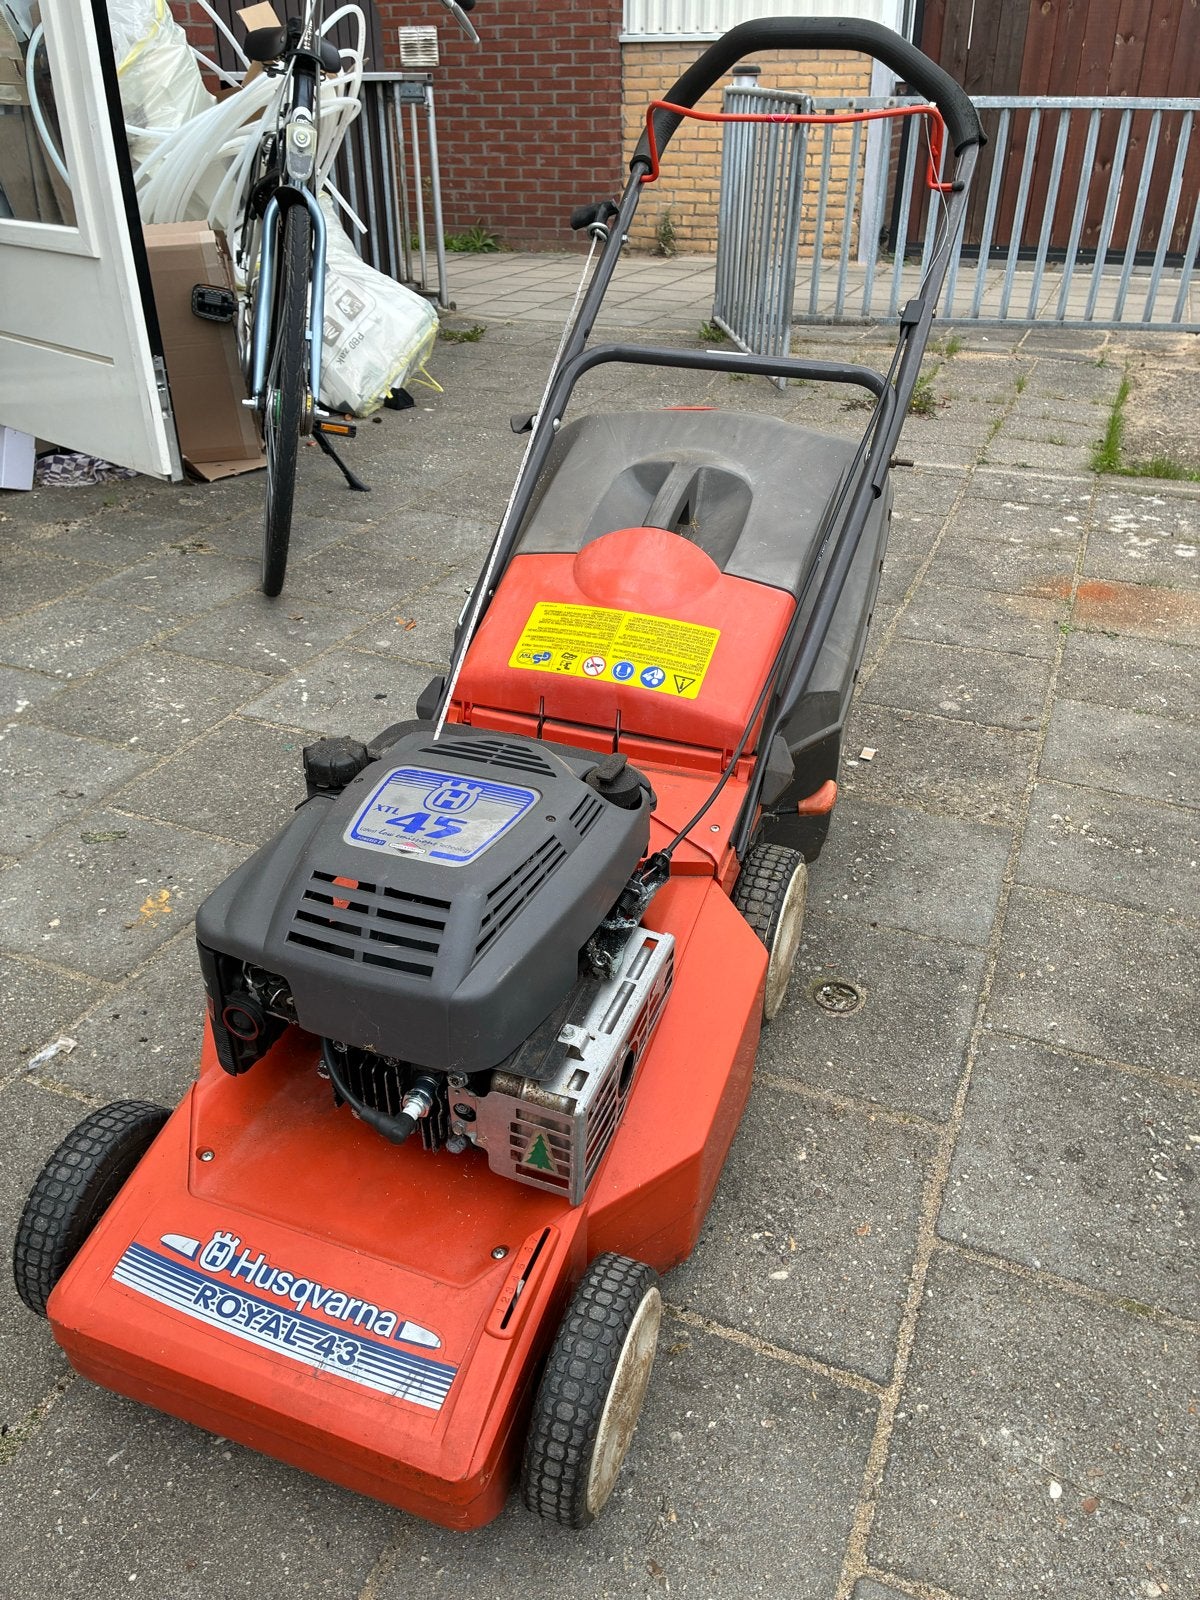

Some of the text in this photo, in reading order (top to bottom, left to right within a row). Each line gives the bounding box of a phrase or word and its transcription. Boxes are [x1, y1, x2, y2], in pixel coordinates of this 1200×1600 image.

[336, 347, 350, 365] zak
[372, 803, 399, 815] XTL
[385, 811, 468, 839] 45
[230, 1247, 398, 1339] Husqvarna
[193, 1284, 361, 1366] ROYAL 43
